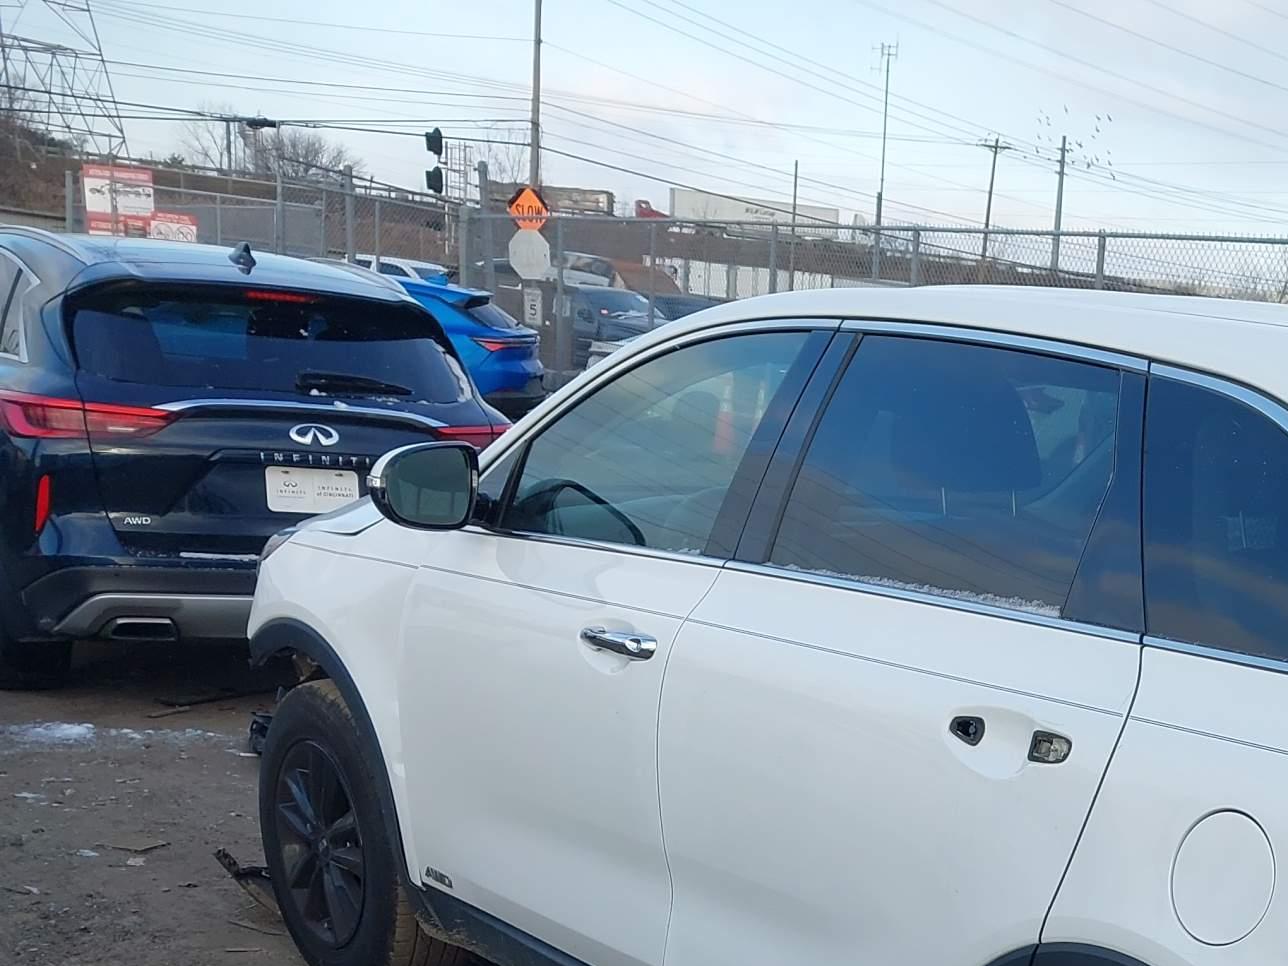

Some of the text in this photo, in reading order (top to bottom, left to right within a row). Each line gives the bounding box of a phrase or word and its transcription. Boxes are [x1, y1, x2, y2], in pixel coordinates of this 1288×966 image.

[515, 204, 544, 223] SLOW
[529, 304, 537, 316] 5
[260, 452, 369, 465] INFINITI
[124, 516, 151, 525] AWD
